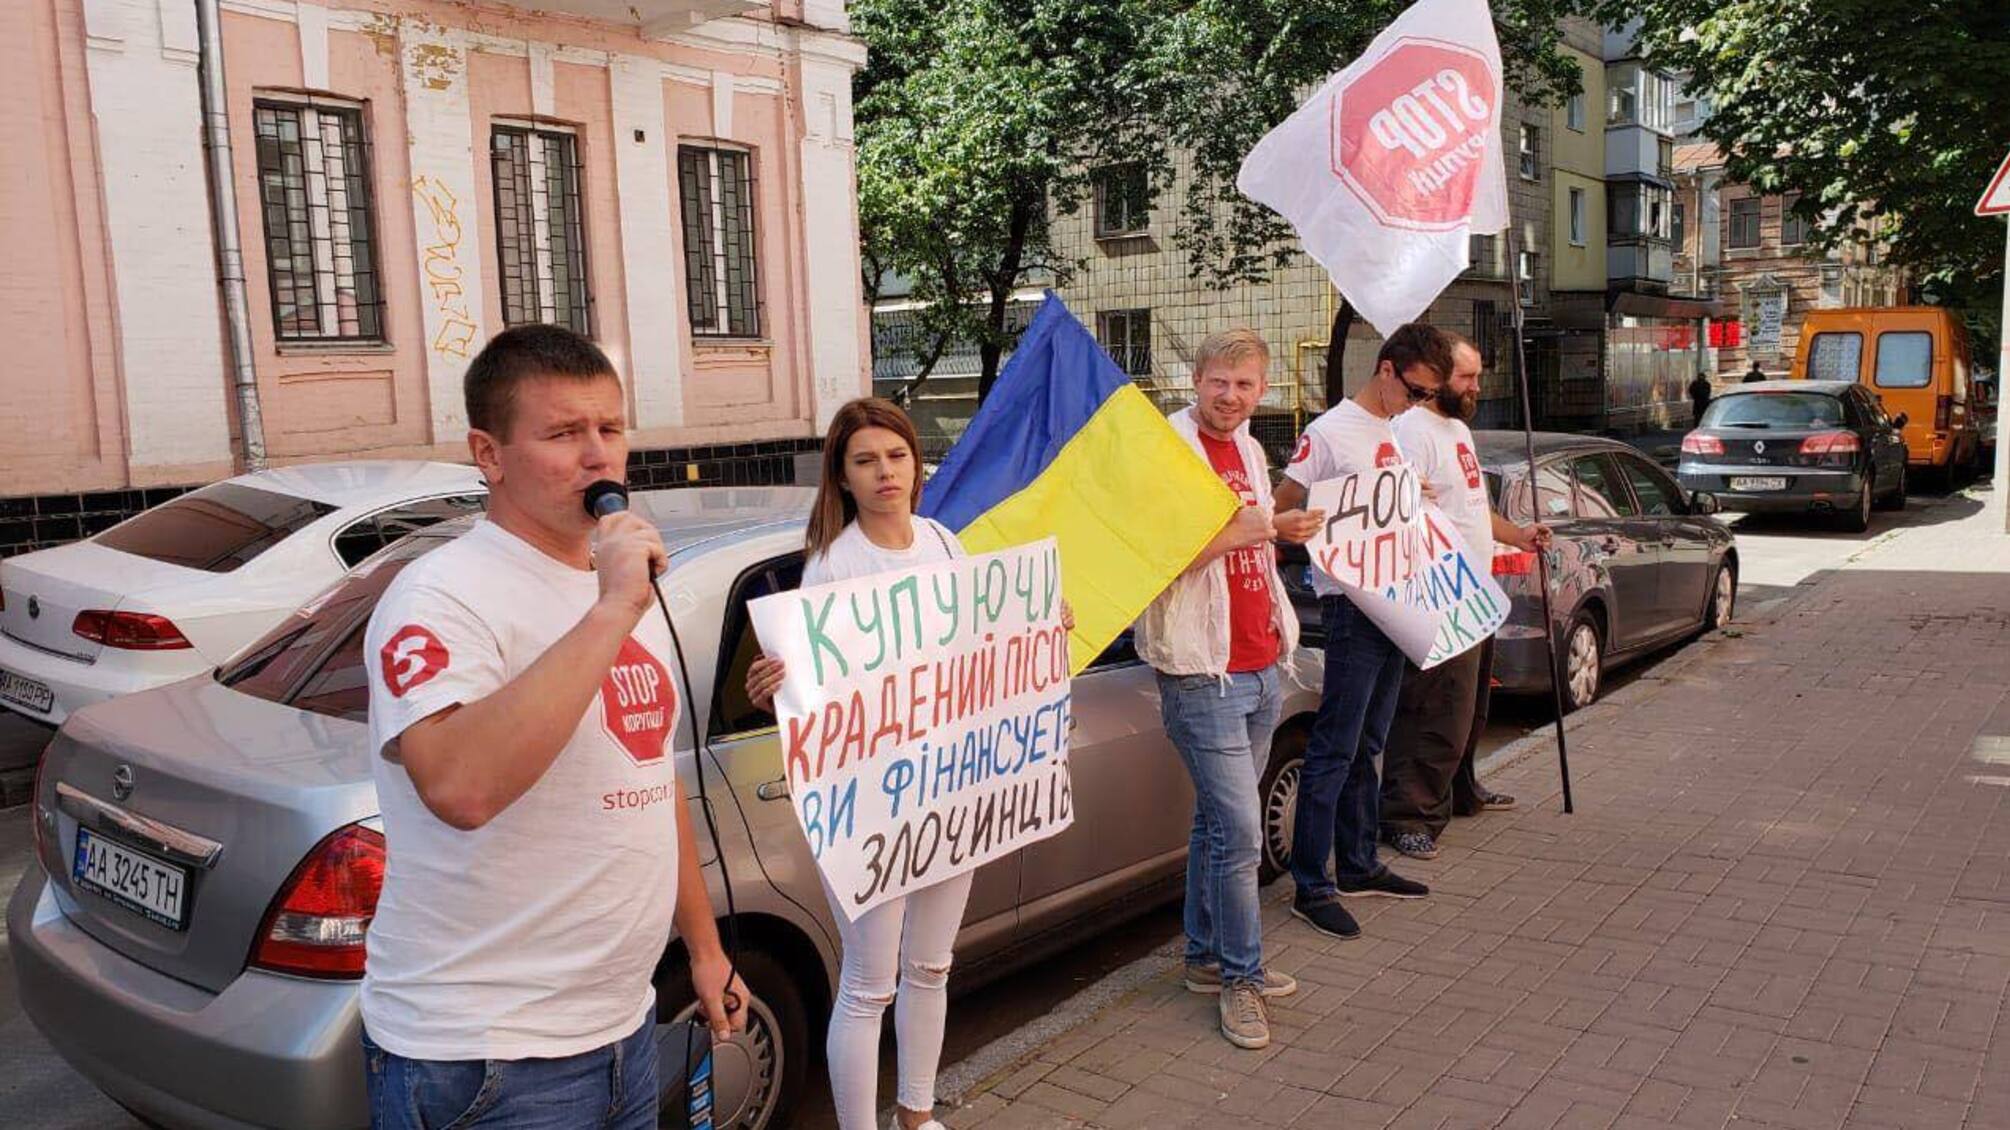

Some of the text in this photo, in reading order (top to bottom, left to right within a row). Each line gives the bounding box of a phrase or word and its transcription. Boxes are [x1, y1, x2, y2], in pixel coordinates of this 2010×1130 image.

[611, 663, 660, 707] STOP
[787, 633, 997, 783] КРАДЕНИЙ
[803, 777, 857, 860] ВИ
[854, 760, 1071, 904] ЗЛОЧИНЦІВ
[86, 842, 107, 883] AA
[112, 852, 150, 899] 3245
[155, 868, 179, 914] TH
